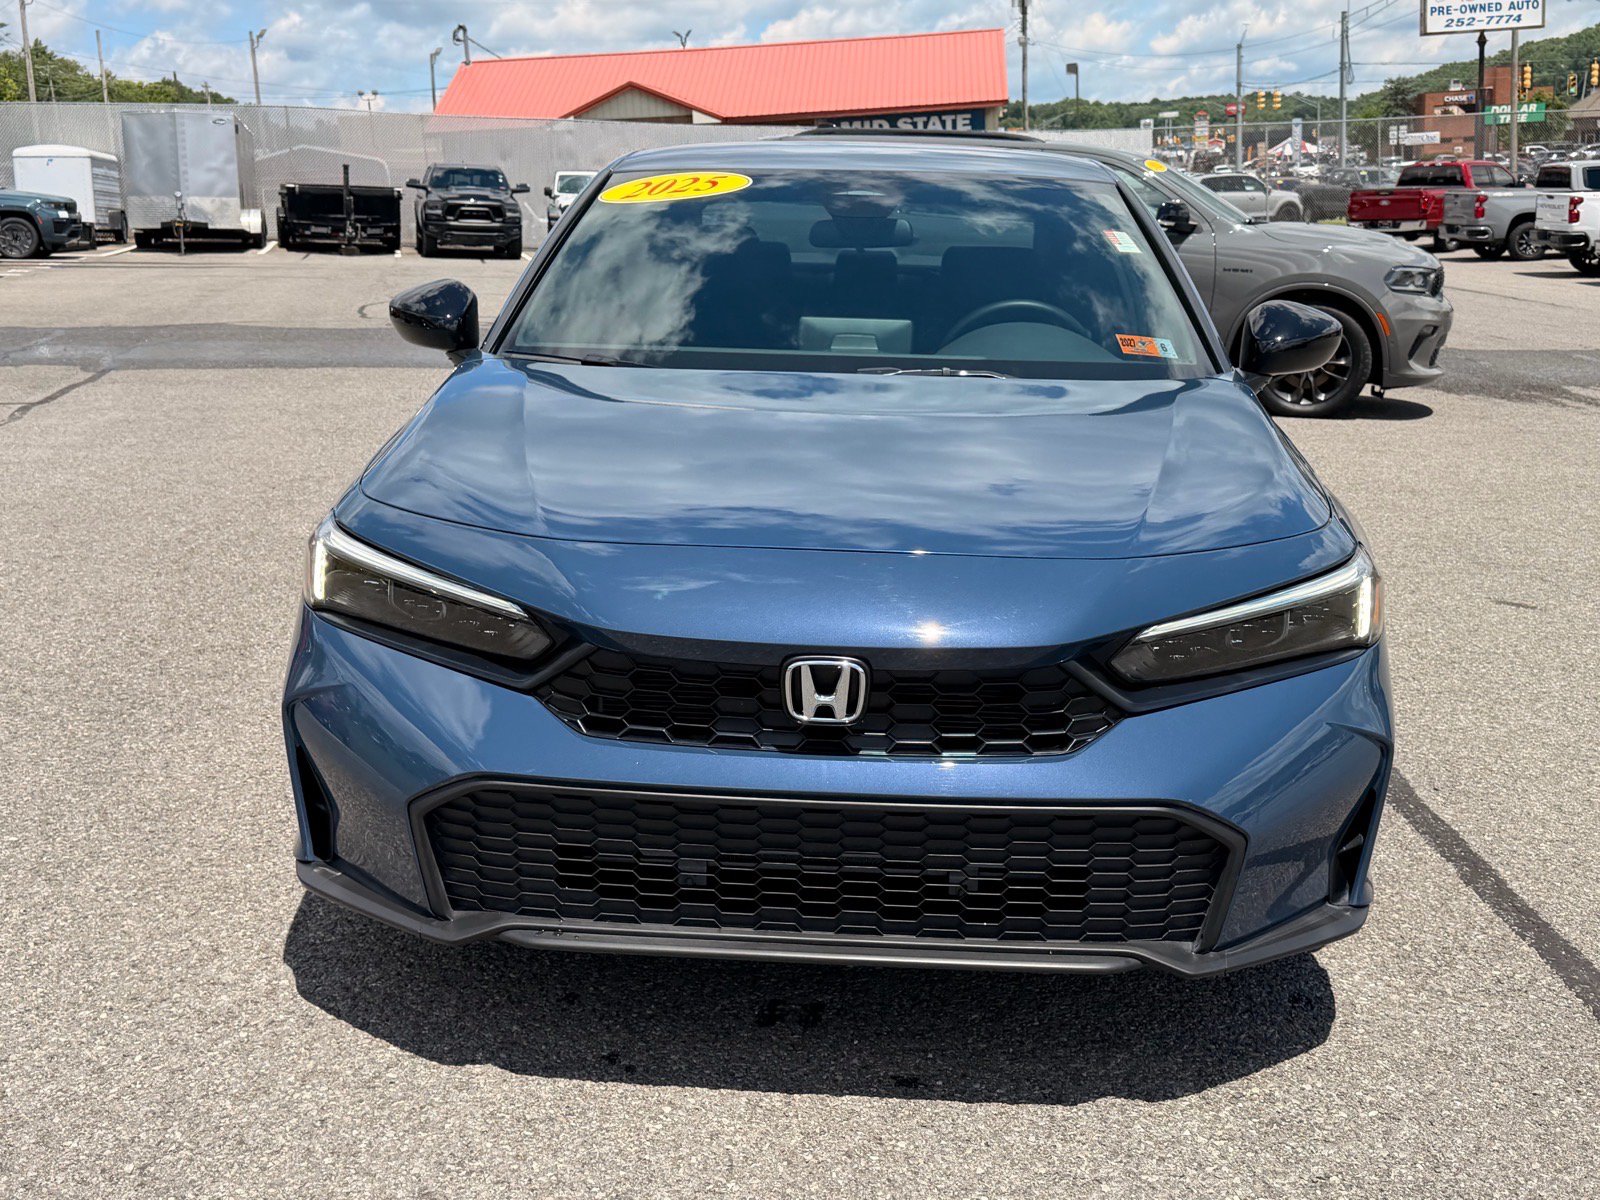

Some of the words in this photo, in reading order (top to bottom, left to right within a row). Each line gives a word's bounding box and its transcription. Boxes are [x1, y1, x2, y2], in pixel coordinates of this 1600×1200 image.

[1430, 2, 1503, 16] PRE-OWNED
[1508, 0, 1540, 11] AUTO
[1444, 14, 1522, 28] 252-7774
[896, 113, 972, 132] STATE
[620, 176, 728, 200] 2025
